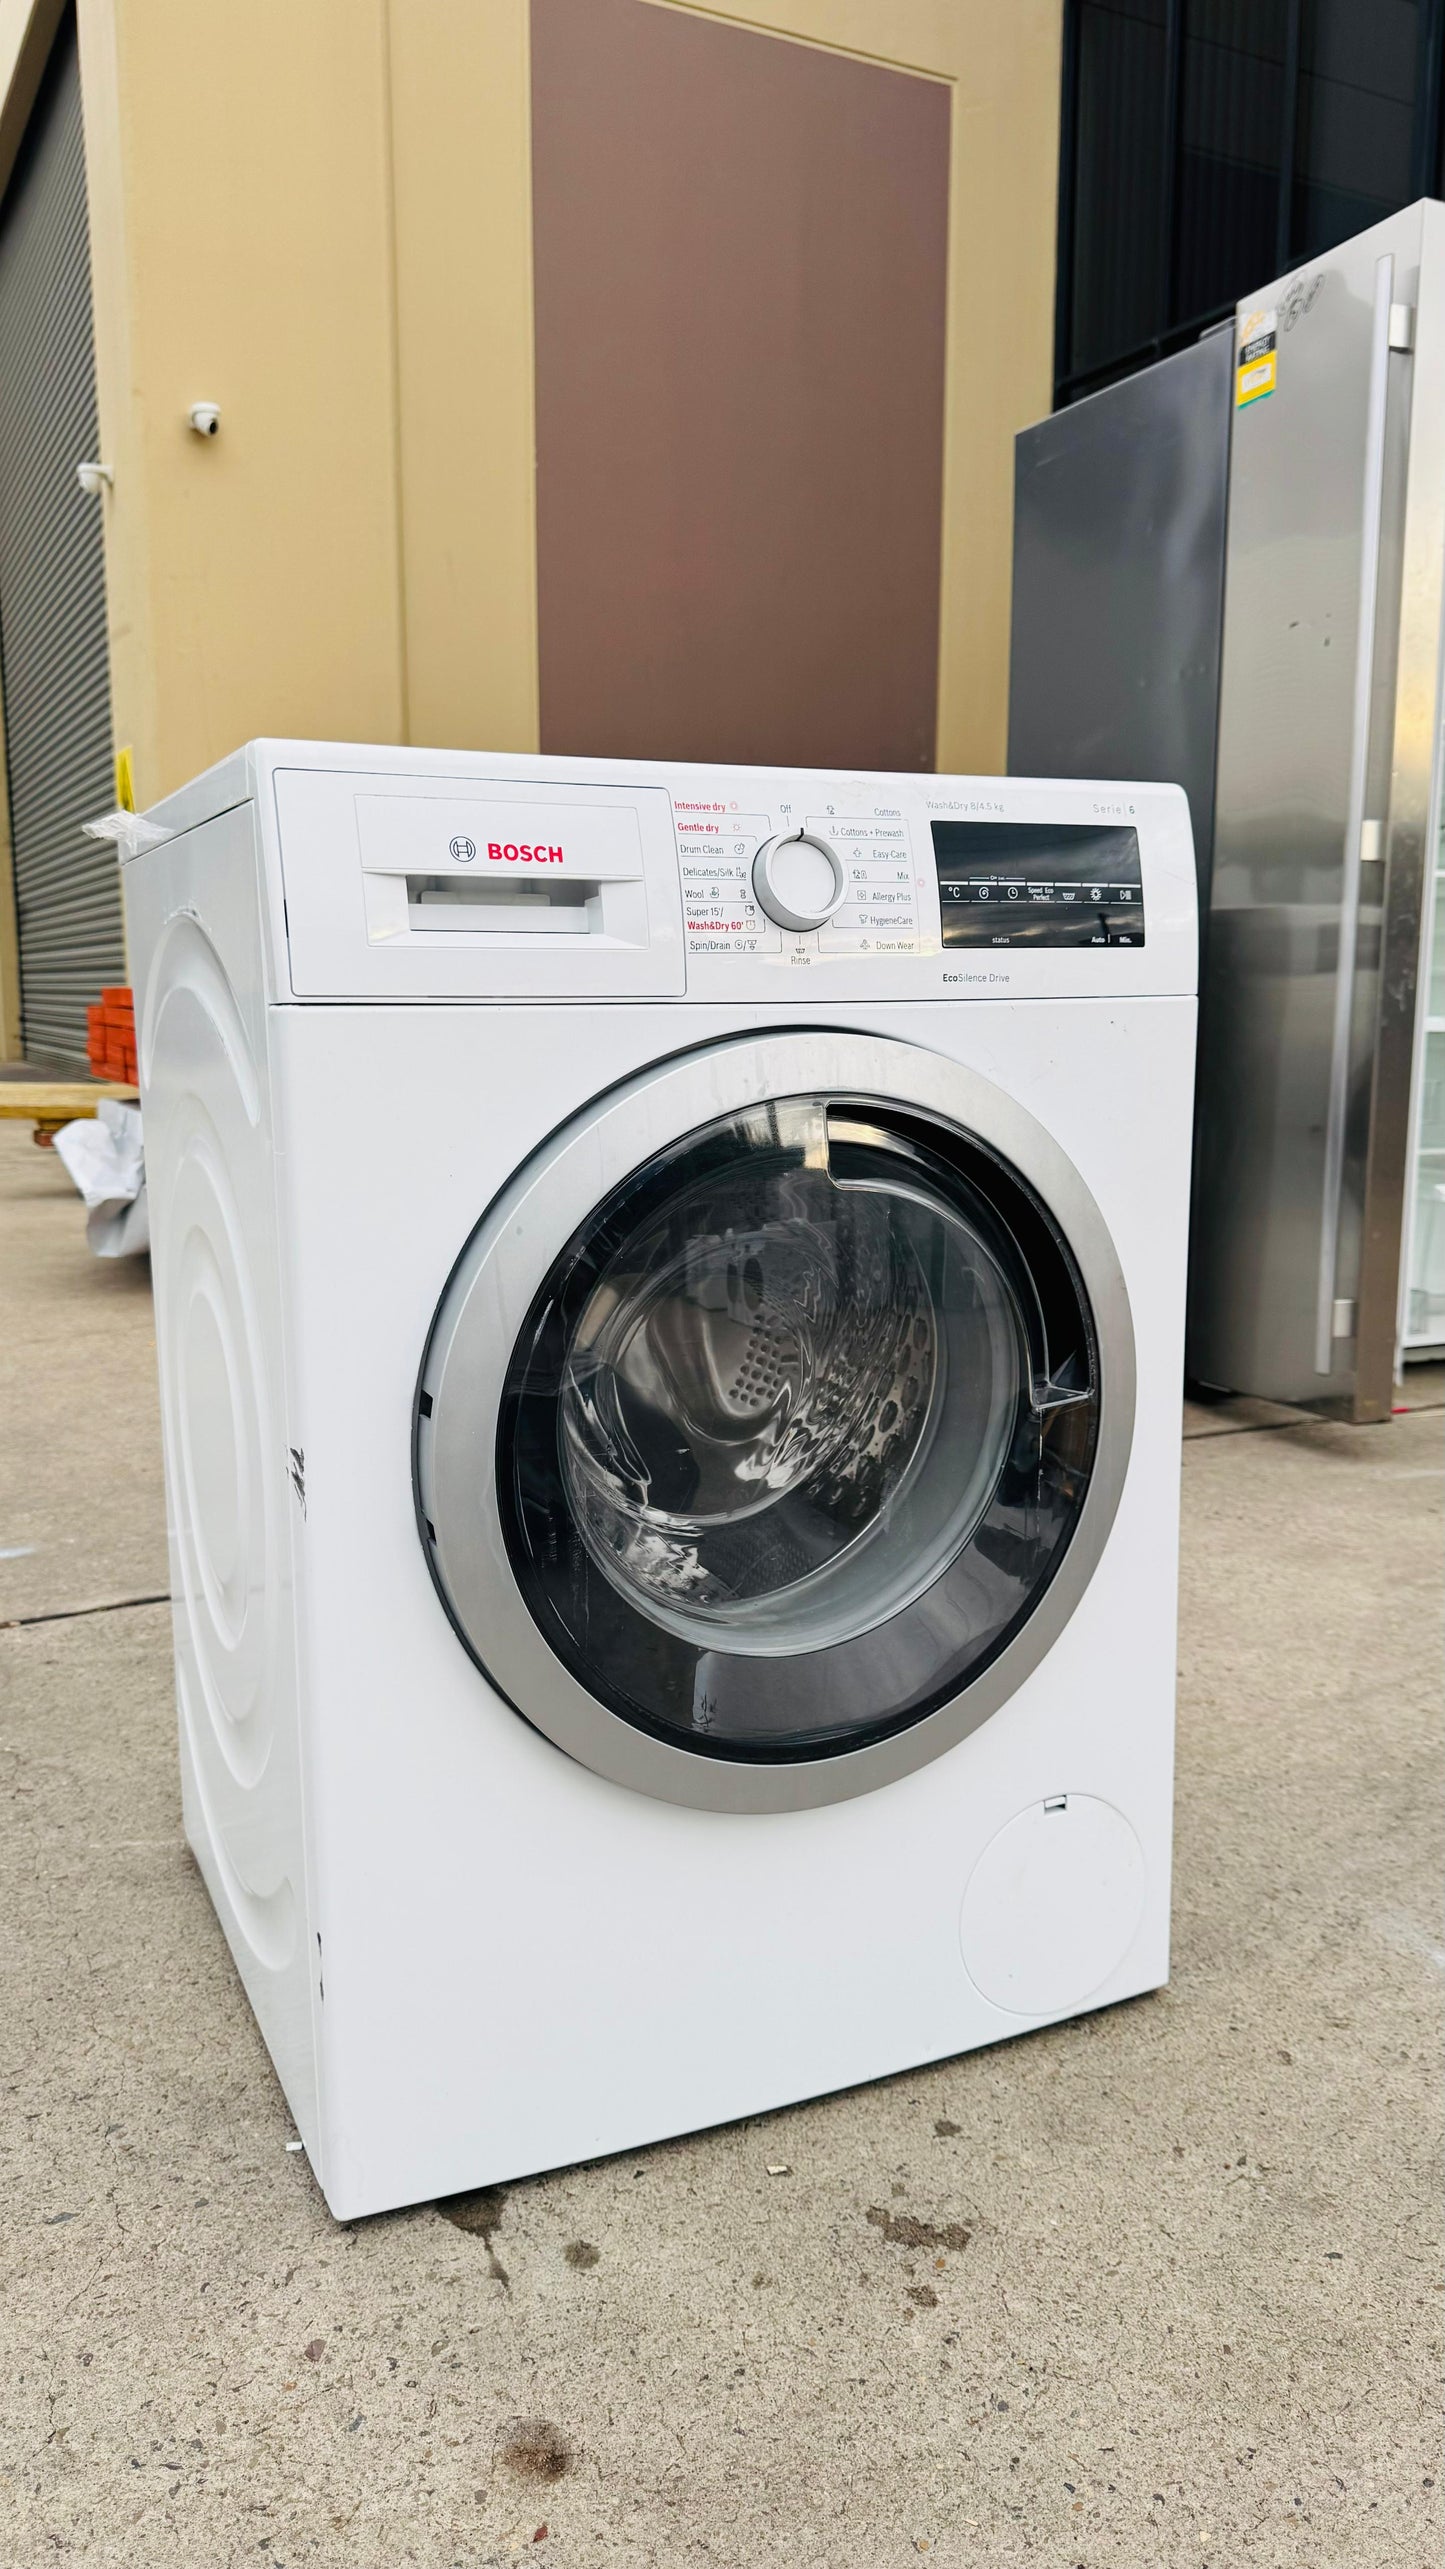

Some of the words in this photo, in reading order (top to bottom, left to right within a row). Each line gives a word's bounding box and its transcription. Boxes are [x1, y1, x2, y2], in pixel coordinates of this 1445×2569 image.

[674, 801, 711, 811] Intensive
[712, 802, 726, 813] dry
[780, 804, 792, 814] Off
[874, 807, 902, 817] Cottons
[926, 801, 969, 812] Wash&Dry
[993, 802, 1005, 813] kg
[1092, 803, 1122, 815] Serie
[1128, 805, 1136, 815] 6
[677, 822, 706, 832] Gentle
[705, 823, 720, 834] dry
[840, 827, 869, 837] Cottons
[874, 828, 905, 838] Prewash
[487, 842, 564, 863] BOSCH
[680, 844, 701, 854] Drum
[702, 844, 724, 855] Clean
[683, 867, 734, 878] Delicates/Silk
[896, 871, 910, 881] Mix
[685, 889, 705, 899] Wool
[872, 892, 896, 903] Allergy
[896, 892, 912, 902] Plus
[947, 886, 961, 899] °C
[686, 906, 709, 918] Super
[687, 920, 730, 932] Wash&Dry
[731, 921, 744, 931] 60'
[870, 915, 914, 927] HygieneCare
[689, 940, 731, 951] Spin/Drain
[876, 940, 896, 951] Down
[896, 941, 915, 951] Wear
[991, 936, 1011, 944] status
[1091, 936, 1106, 944] Auto
[790, 955, 811, 965] Rinse
[942, 973, 987, 983] EcoSilence
[988, 973, 1010, 983] Drive
